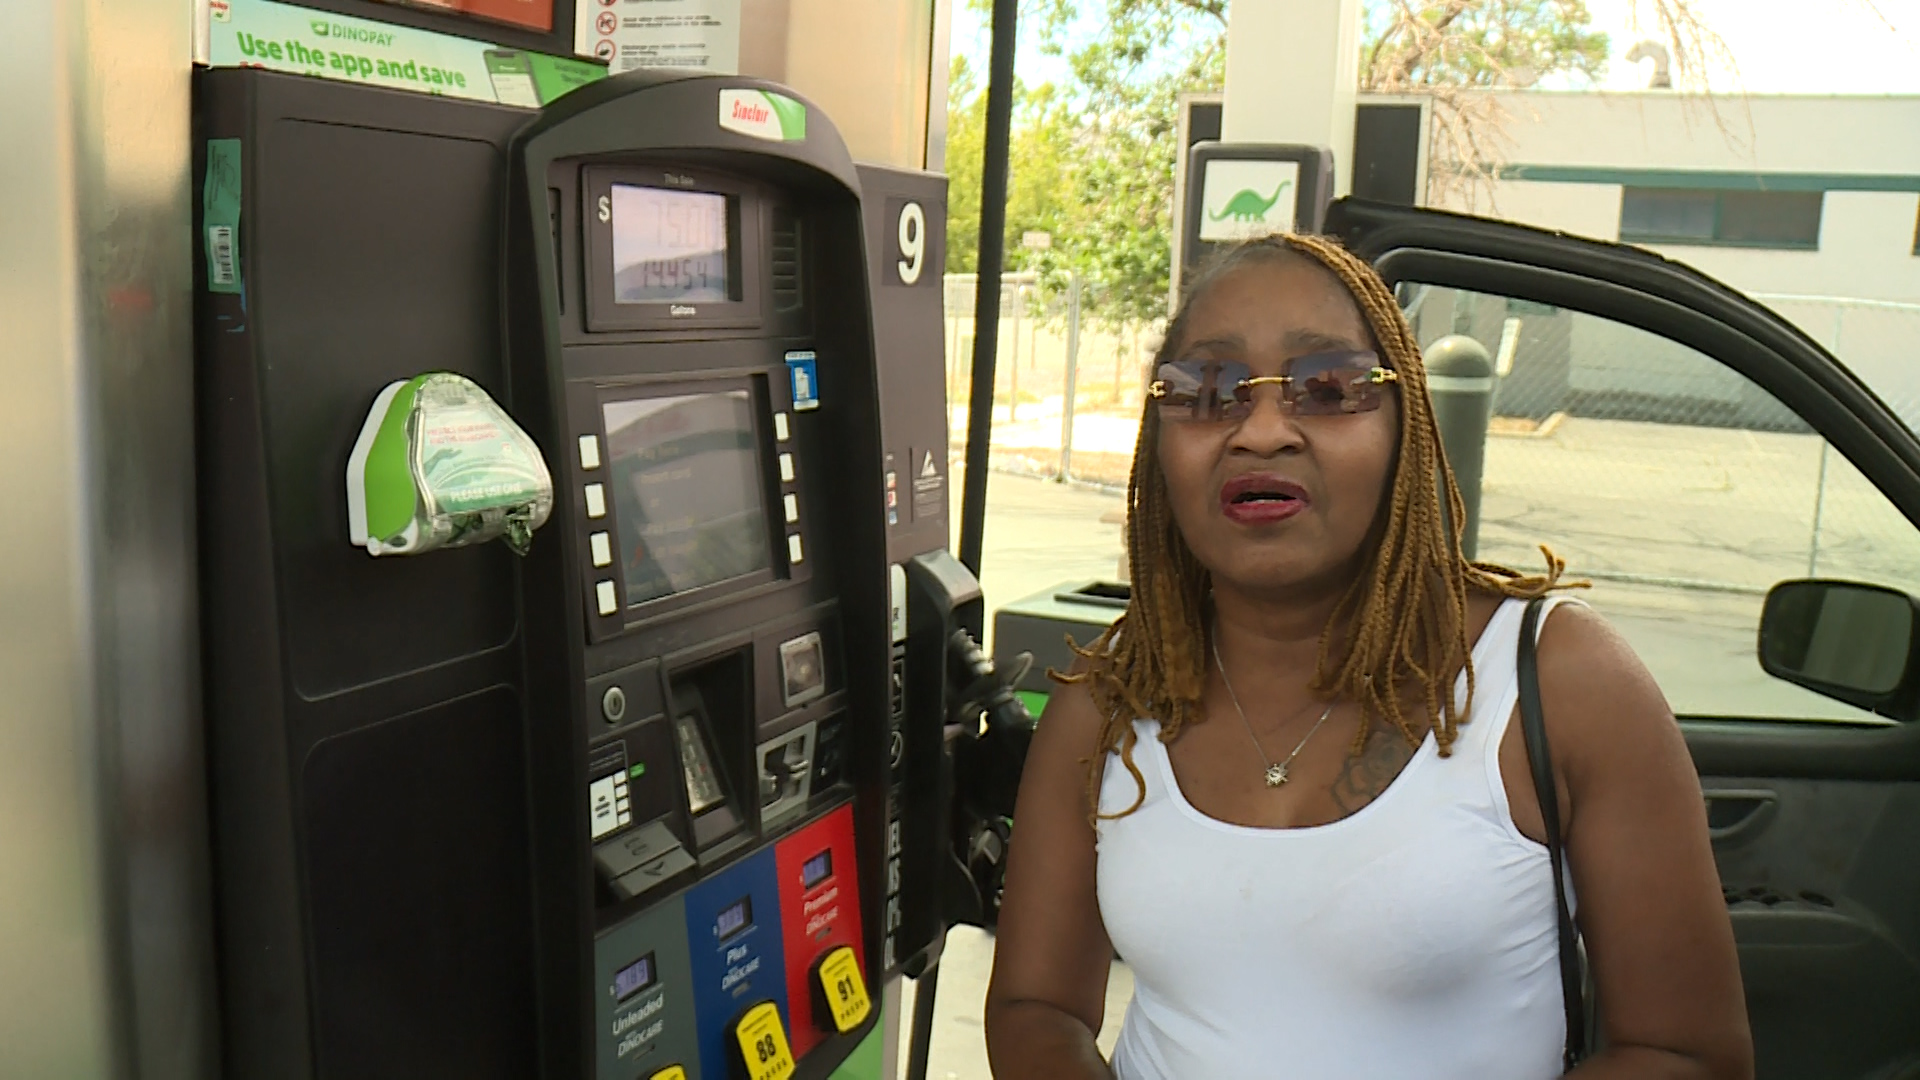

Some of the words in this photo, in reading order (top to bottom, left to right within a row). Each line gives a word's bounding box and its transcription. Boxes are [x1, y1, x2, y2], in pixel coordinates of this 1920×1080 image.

[332, 23, 394, 46] DINOPAY
[236, 31, 283, 60] Use
[285, 40, 326, 68] the
[329, 51, 373, 79] app
[376, 58, 418, 81] and
[420, 65, 467, 88] save
[732, 99, 768, 123] Sinclair
[598, 195, 609, 223] $
[898, 202, 925, 285] 9
[838, 974, 854, 1002] 91
[613, 992, 663, 1036] Unleaded
[756, 1033, 776, 1064] 88
